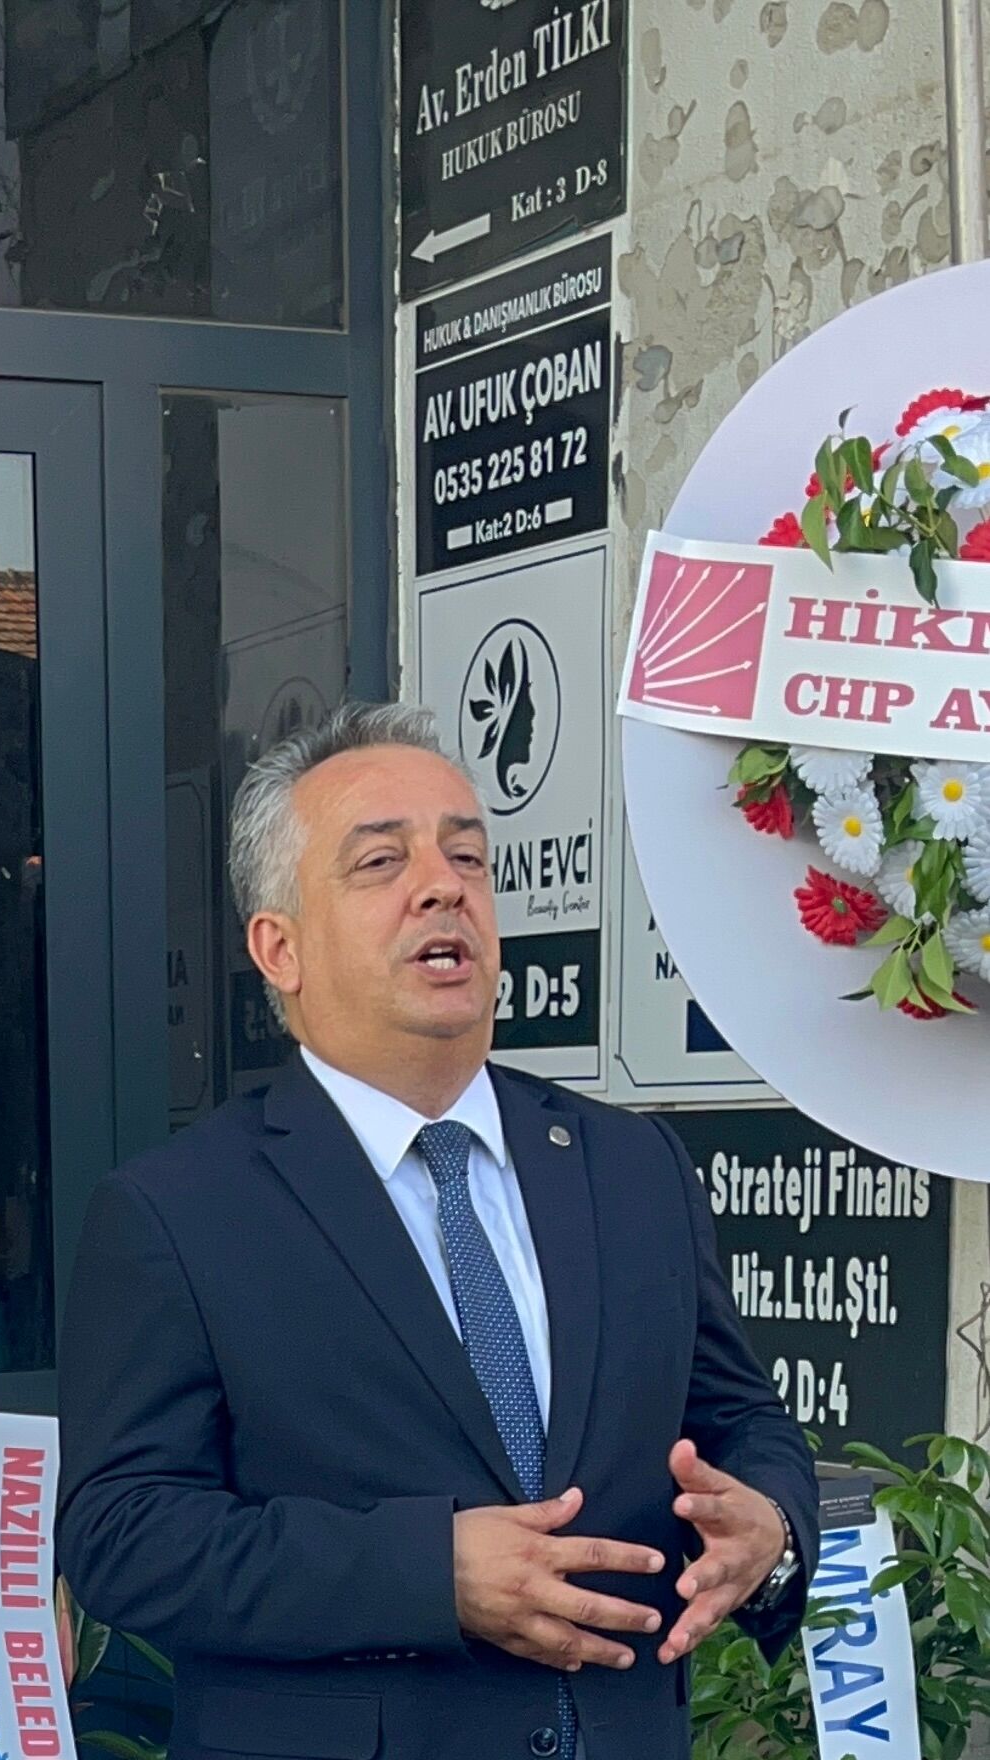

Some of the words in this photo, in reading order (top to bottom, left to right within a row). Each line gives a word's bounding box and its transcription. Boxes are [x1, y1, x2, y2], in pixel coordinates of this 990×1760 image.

[416, 84, 449, 135] Av.
[455, 47, 527, 117] Erden
[442, 127, 503, 181] HUKUK
[506, 90, 581, 151] BÜROSU
[511, 186, 542, 223] Kat
[555, 177, 566, 203] 3
[574, 158, 608, 195] D-8
[424, 319, 461, 353] HUKUK
[463, 316, 472, 338] &
[474, 286, 551, 333] DANIŞMANLIK
[553, 267, 602, 307] BÜROSU
[423, 390, 456, 443] AV.
[460, 369, 517, 431] UFUK
[521, 340, 601, 425] ÇOBAN
[434, 458, 482, 505] 0535
[487, 445, 524, 490] 225
[530, 436, 553, 478] 81
[560, 426, 587, 468] 72
[475, 512, 512, 544] Kat:2
[515, 504, 542, 534] D:6
[784, 672, 915, 724] CHP
[495, 971, 514, 1020] 2
[526, 965, 581, 1018] D:5
[711, 1147, 822, 1234] Strateji
[828, 1147, 931, 1218] Finans
[731, 1251, 898, 1339] Hiz.Ltd.Şti.
[797, 1359, 848, 1427] D:4
[0, 1447, 46, 1608] NAZİLLİ
[809, 1529, 891, 1743] MİRAY
